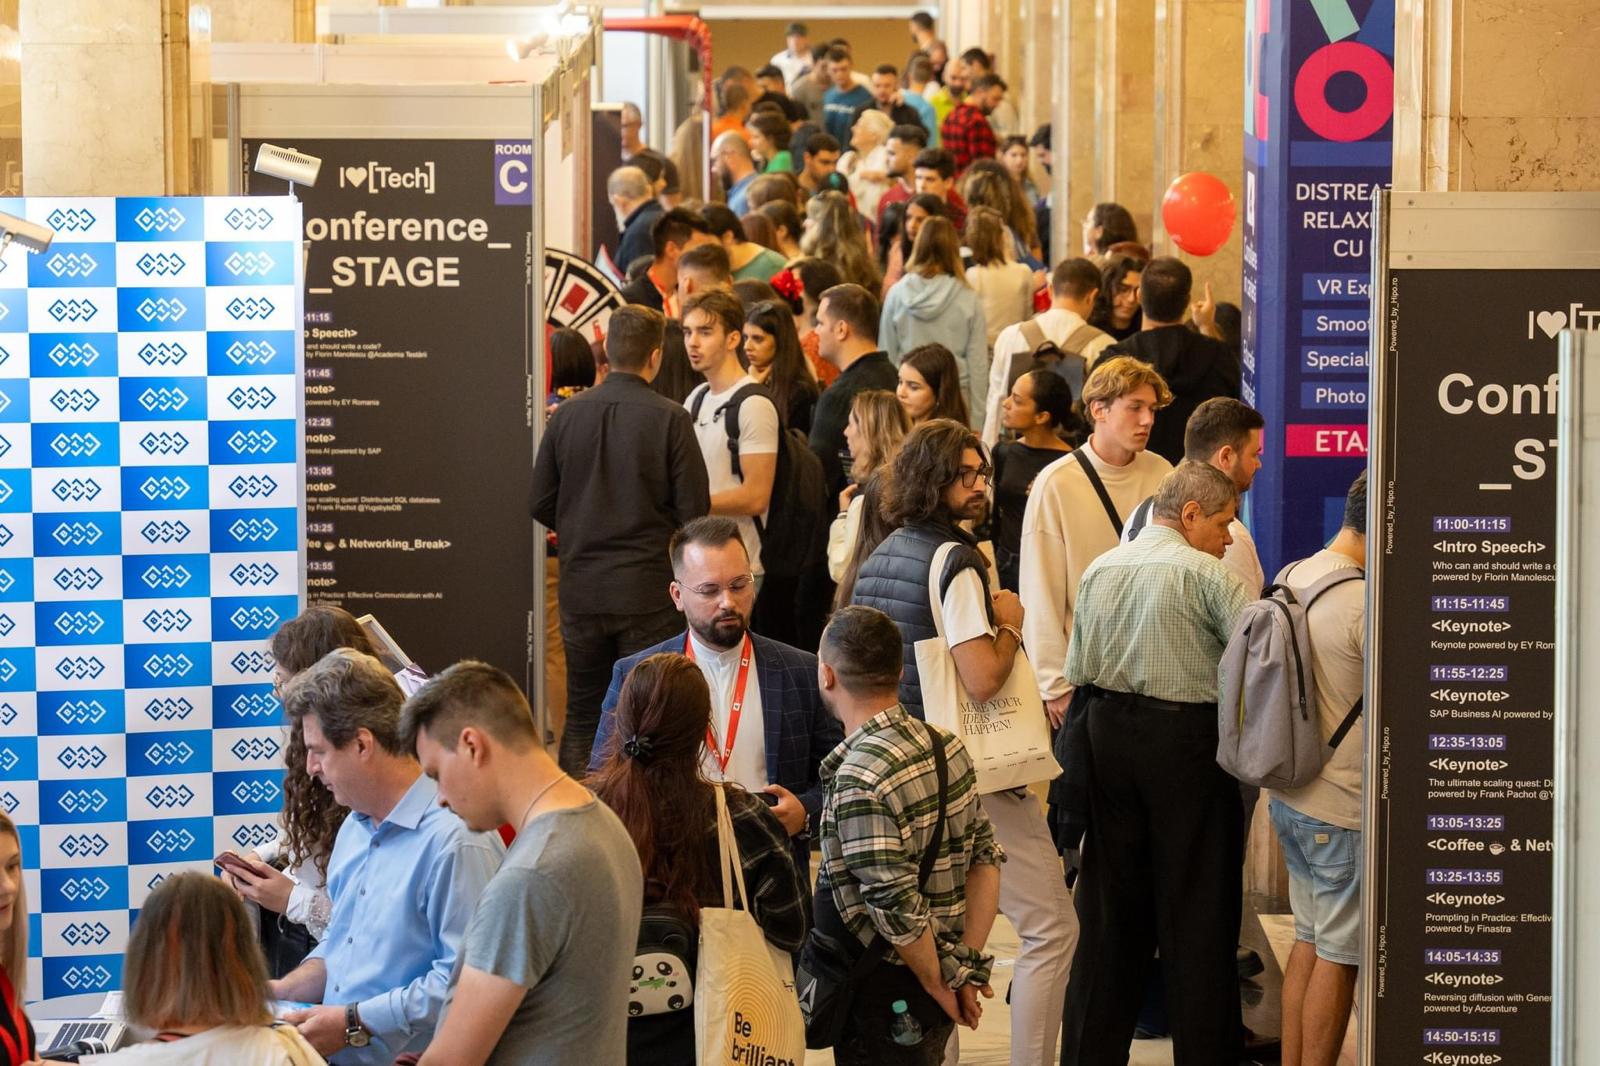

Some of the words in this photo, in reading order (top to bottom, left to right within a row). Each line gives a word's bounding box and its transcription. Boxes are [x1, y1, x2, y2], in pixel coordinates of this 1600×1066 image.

[496, 144, 532, 154] ROOM
[368, 162, 435, 194] [Tech]
[500, 160, 528, 193] C
[1296, 183, 1392, 200] DISTREA
[1304, 212, 1372, 229] RELAX
[1334, 240, 1363, 256] CU
[309, 256, 460, 294] _STAGE
[1317, 280, 1342, 294] VR
[312, 328, 358, 339] Speech>
[1316, 388, 1365, 403] Photo
[1316, 430, 1368, 452] ETA
[1436, 519, 1506, 530] 11:00-11:15
[350, 539, 451, 551] Networking_Break>
[1433, 540, 1477, 552] <Intro
[1482, 540, 1546, 555] Speech>
[1433, 562, 1452, 570] Who
[1473, 562, 1489, 570] and
[1492, 562, 1520, 570] should
[1522, 562, 1542, 570] write
[1432, 573, 1469, 582] powered
[1472, 573, 1482, 582] by
[1484, 573, 1508, 581] Florin
[1434, 598, 1504, 609] 11:15-11:45
[1432, 620, 1511, 635] <Keynote>
[1431, 641, 1466, 651] Keynote
[1469, 642, 1505, 650] powered
[1508, 641, 1518, 651] by
[1521, 641, 1533, 649] EY
[1433, 668, 1504, 678] 11:55-12:25
[1430, 689, 1510, 704] <Keynote>
[960, 702, 990, 713] MAKE
[990, 697, 1022, 709] YOUR
[963, 713, 990, 724] IDEAS
[1430, 710, 1449, 718] SAP
[1452, 710, 1490, 718] Business
[1492, 710, 1500, 718] AI
[1504, 710, 1540, 719] powered
[1543, 710, 1553, 720] by
[964, 720, 1012, 736] HAPPEN!
[1432, 737, 1503, 748] 12:35-13:05
[1429, 758, 1508, 773] <Keynote>
[1429, 778, 1444, 786] The
[1483, 779, 1513, 788] scaling
[1516, 779, 1541, 788] quest:
[1428, 790, 1464, 799] powered
[1467, 790, 1478, 800] by
[1480, 790, 1504, 798] Frank
[1430, 818, 1501, 828] 13:05-13:25
[1427, 839, 1484, 851] <Coffee
[1510, 839, 1521, 851] &
[1429, 872, 1500, 882] 13:25-13:55
[1426, 893, 1505, 907] <Keynote>
[1426, 913, 1468, 922] Prompting
[1482, 914, 1518, 922] Practice:
[1426, 925, 1462, 934] powered
[1464, 925, 1474, 934] by
[1477, 925, 1511, 933] Finastra
[1428, 952, 1498, 962] 14:05-14:35
[1425, 972, 1503, 987] <Keynote>
[1424, 993, 1466, 1002] Reversing
[1469, 994, 1504, 1002] diffusion
[1424, 1005, 1460, 1013] powered
[1463, 1005, 1473, 1014] by
[735, 1012, 751, 1037] Be
[1426, 1032, 1496, 1042] 14:50-15:15
[1424, 1052, 1502, 1066] <Keynote>
